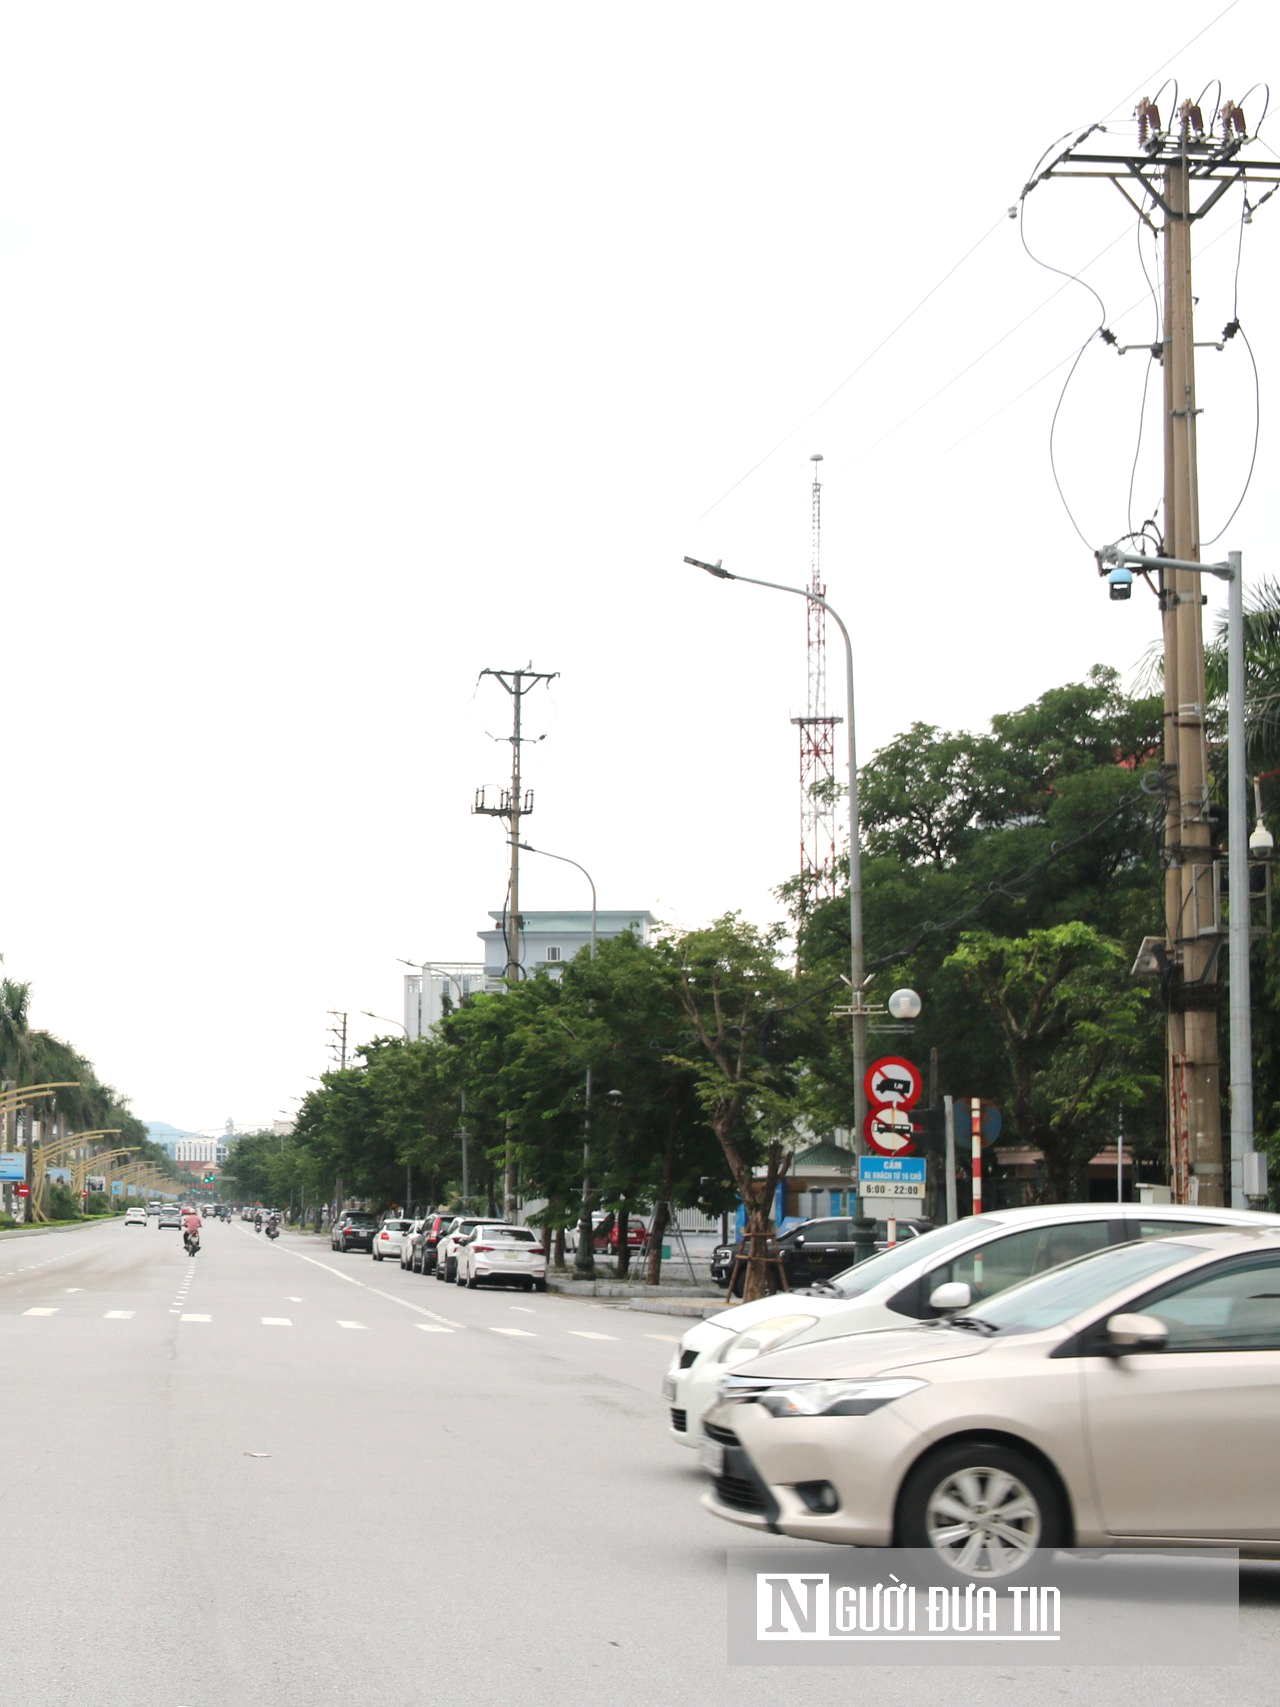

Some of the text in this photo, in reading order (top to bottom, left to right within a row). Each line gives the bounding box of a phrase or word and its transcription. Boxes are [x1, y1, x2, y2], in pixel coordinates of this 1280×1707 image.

[883, 1159, 902, 1170] CẤM
[864, 1171, 871, 1179] XE
[872, 1170, 892, 1179] KHÁCH
[866, 1184, 885, 1194] 6:00
[894, 1185, 918, 1195] 22:00
